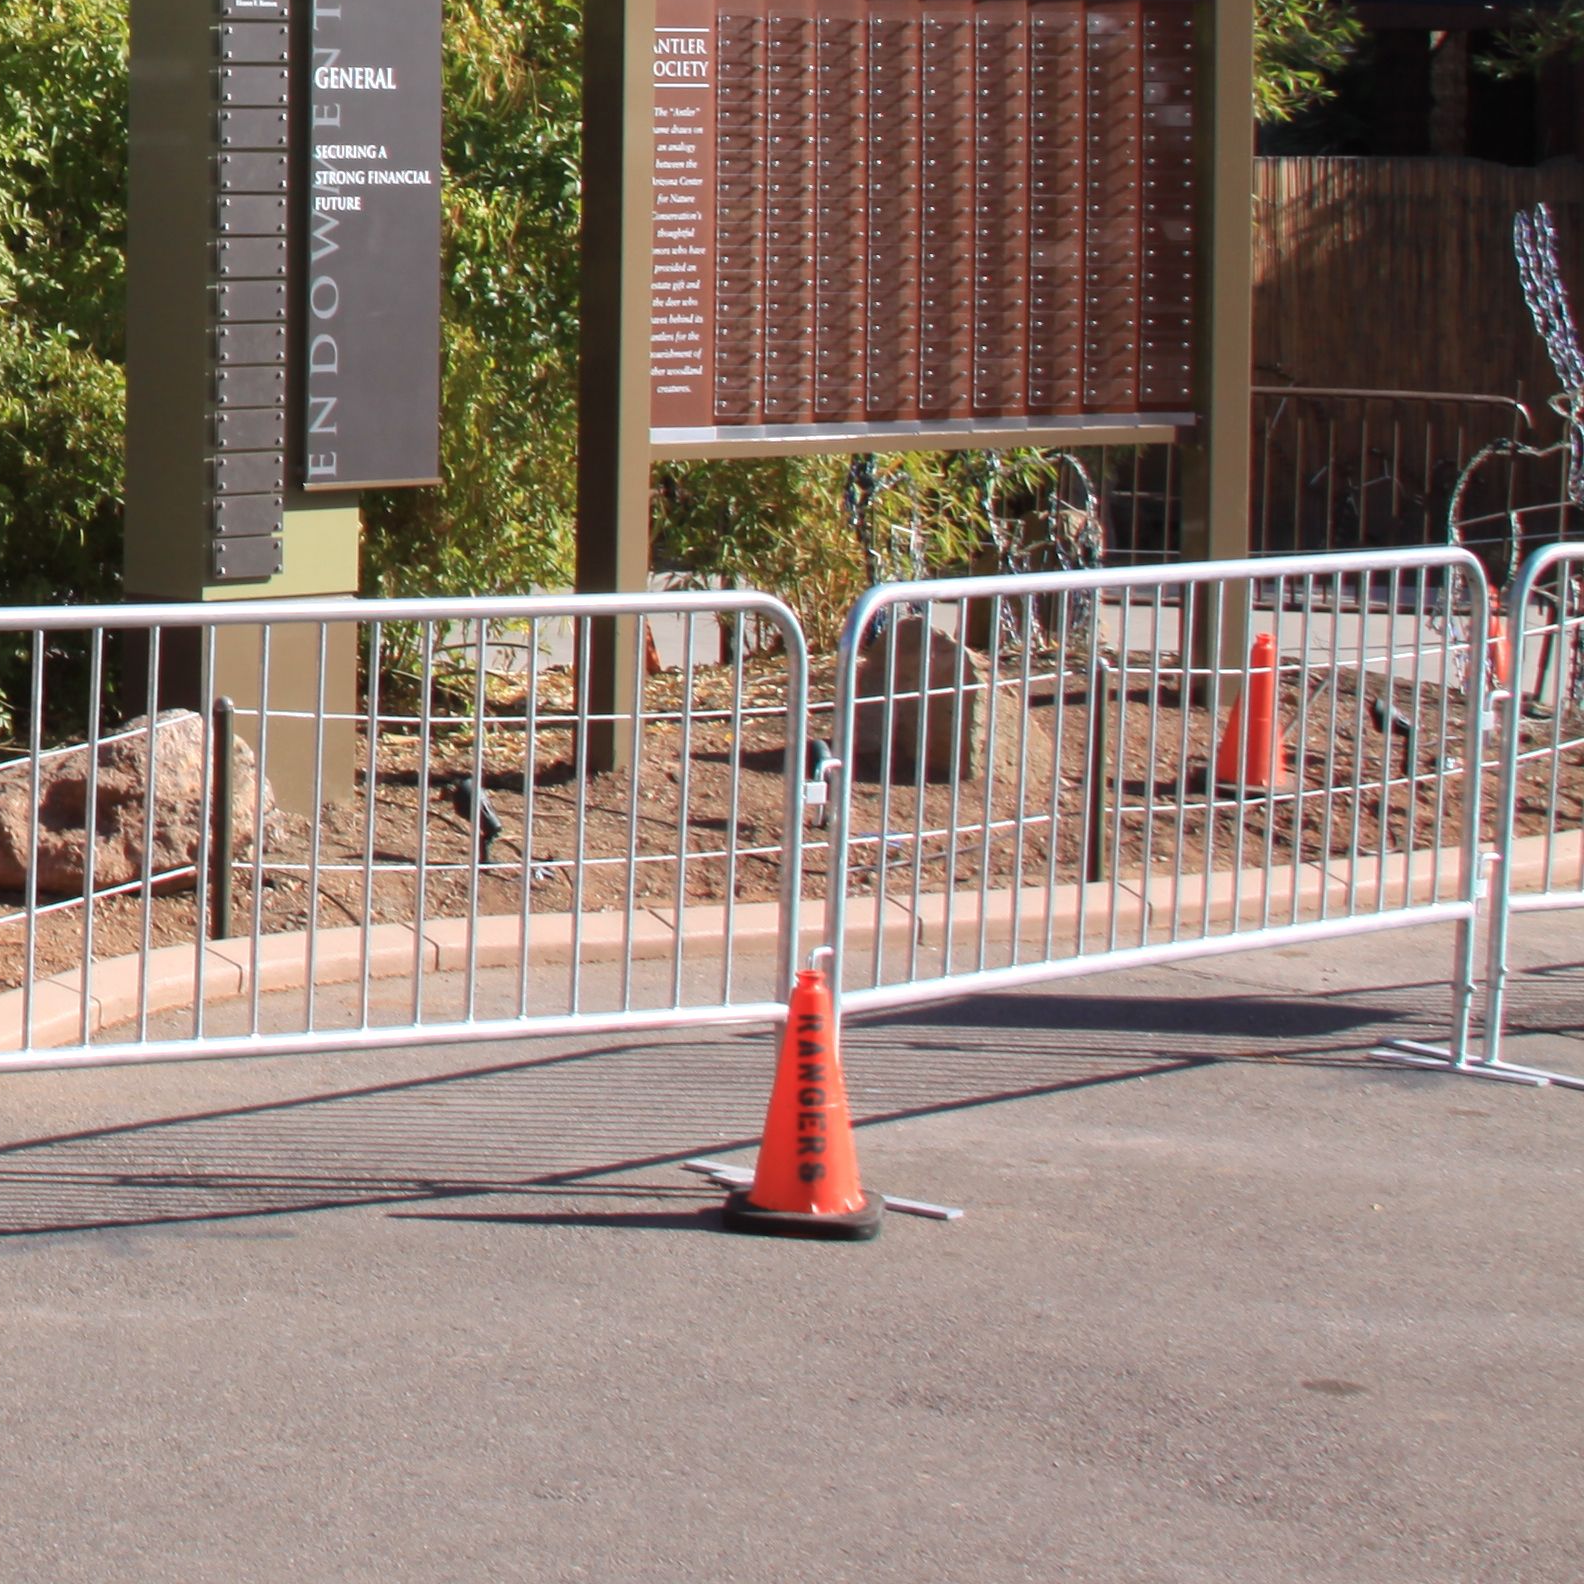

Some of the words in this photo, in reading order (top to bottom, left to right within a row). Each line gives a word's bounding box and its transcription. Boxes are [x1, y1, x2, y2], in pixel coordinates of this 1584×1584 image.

[653, 60, 709, 77] OCIETY
[314, 66, 396, 90] GENERAL
[654, 107, 668, 116] The
[671, 124, 692, 134] draws
[315, 144, 376, 159] SECURING
[378, 145, 388, 159] A
[657, 144, 667, 152] an
[668, 141, 696, 153] analogy
[656, 159, 685, 168] between
[686, 159, 698, 168] the
[315, 170, 365, 185] STRONG
[367, 170, 431, 185] FINANCIAL
[679, 177, 703, 186] Center
[315, 196, 361, 211] FUTURE
[657, 194, 669, 205] for
[670, 194, 696, 203] Nature
[657, 228, 695, 239] thoughtful
[672, 245, 687, 255] who
[689, 245, 706, 255] have
[654, 262, 686, 274] provided
[672, 279, 685, 292] gift
[686, 279, 701, 289] and
[652, 297, 664, 307] the
[665, 297, 681, 306] deer
[682, 297, 698, 306] who
[669, 314, 693, 323] behind
[675, 331, 687, 343] for
[688, 331, 700, 341] the
[693, 348, 703, 359] of
[667, 365, 703, 375] woodland
[796, 1013, 826, 1184] RANGERS
